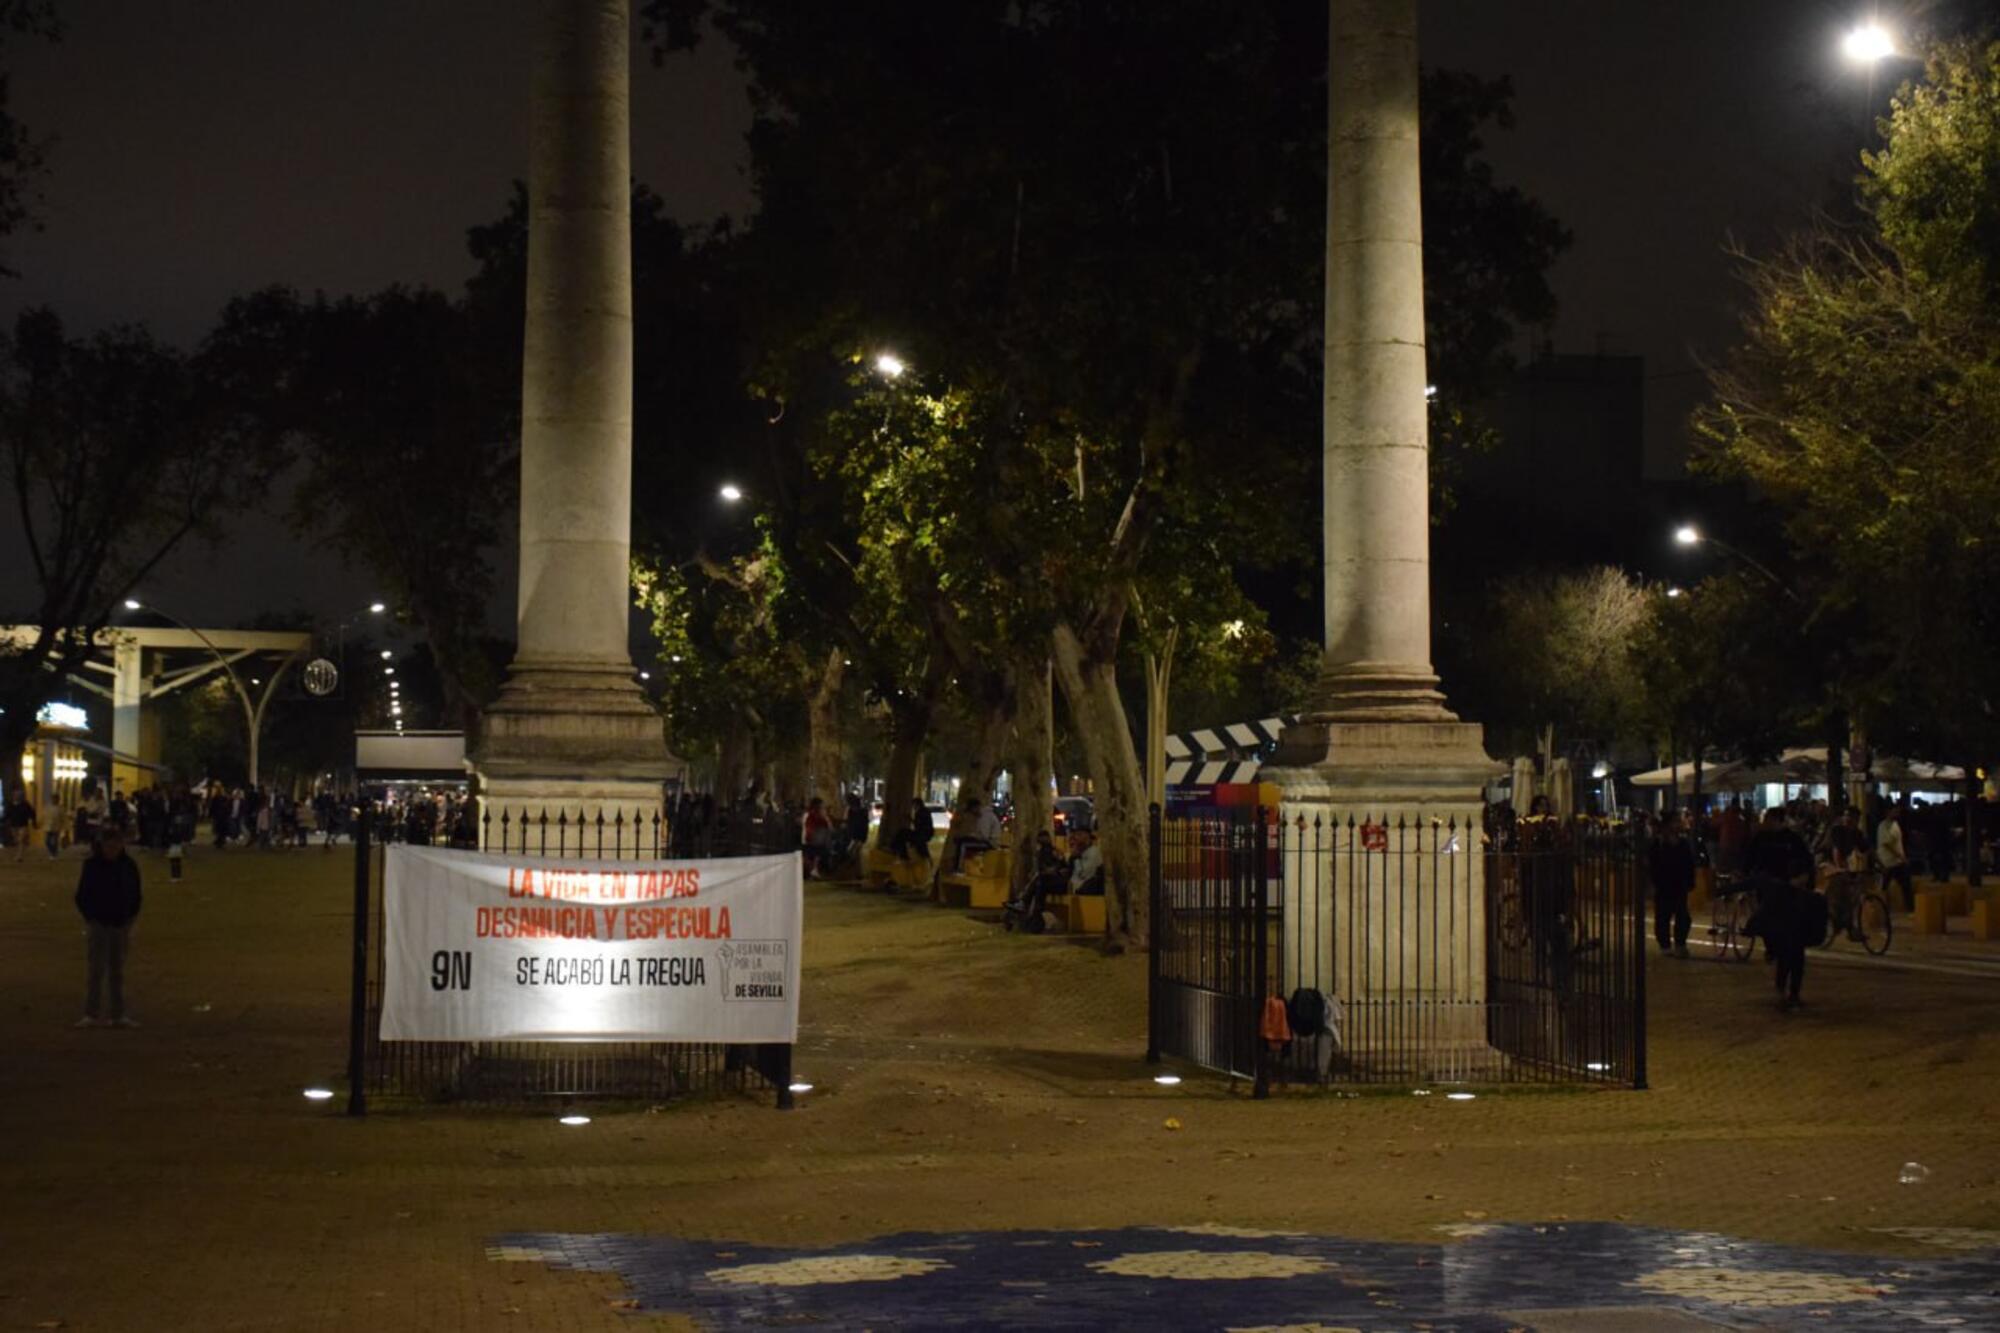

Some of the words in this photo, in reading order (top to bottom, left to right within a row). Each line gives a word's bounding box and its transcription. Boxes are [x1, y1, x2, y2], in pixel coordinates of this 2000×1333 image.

[508, 868, 534, 898] LA
[542, 868, 592, 899] VIDA
[600, 869, 626, 899] EN
[635, 868, 700, 898] TAPAS
[476, 906, 597, 939] DESAHUCIA
[601, 907, 618, 939] Y
[625, 906, 731, 939] ESPECULA
[430, 950, 472, 991] 9N
[516, 957, 539, 986] SE
[544, 954, 604, 986] ACABÓ
[610, 958, 631, 985] LA
[637, 957, 705, 986] TREGUA
[735, 984, 747, 998] DE
[747, 984, 784, 998] SEVILLA
